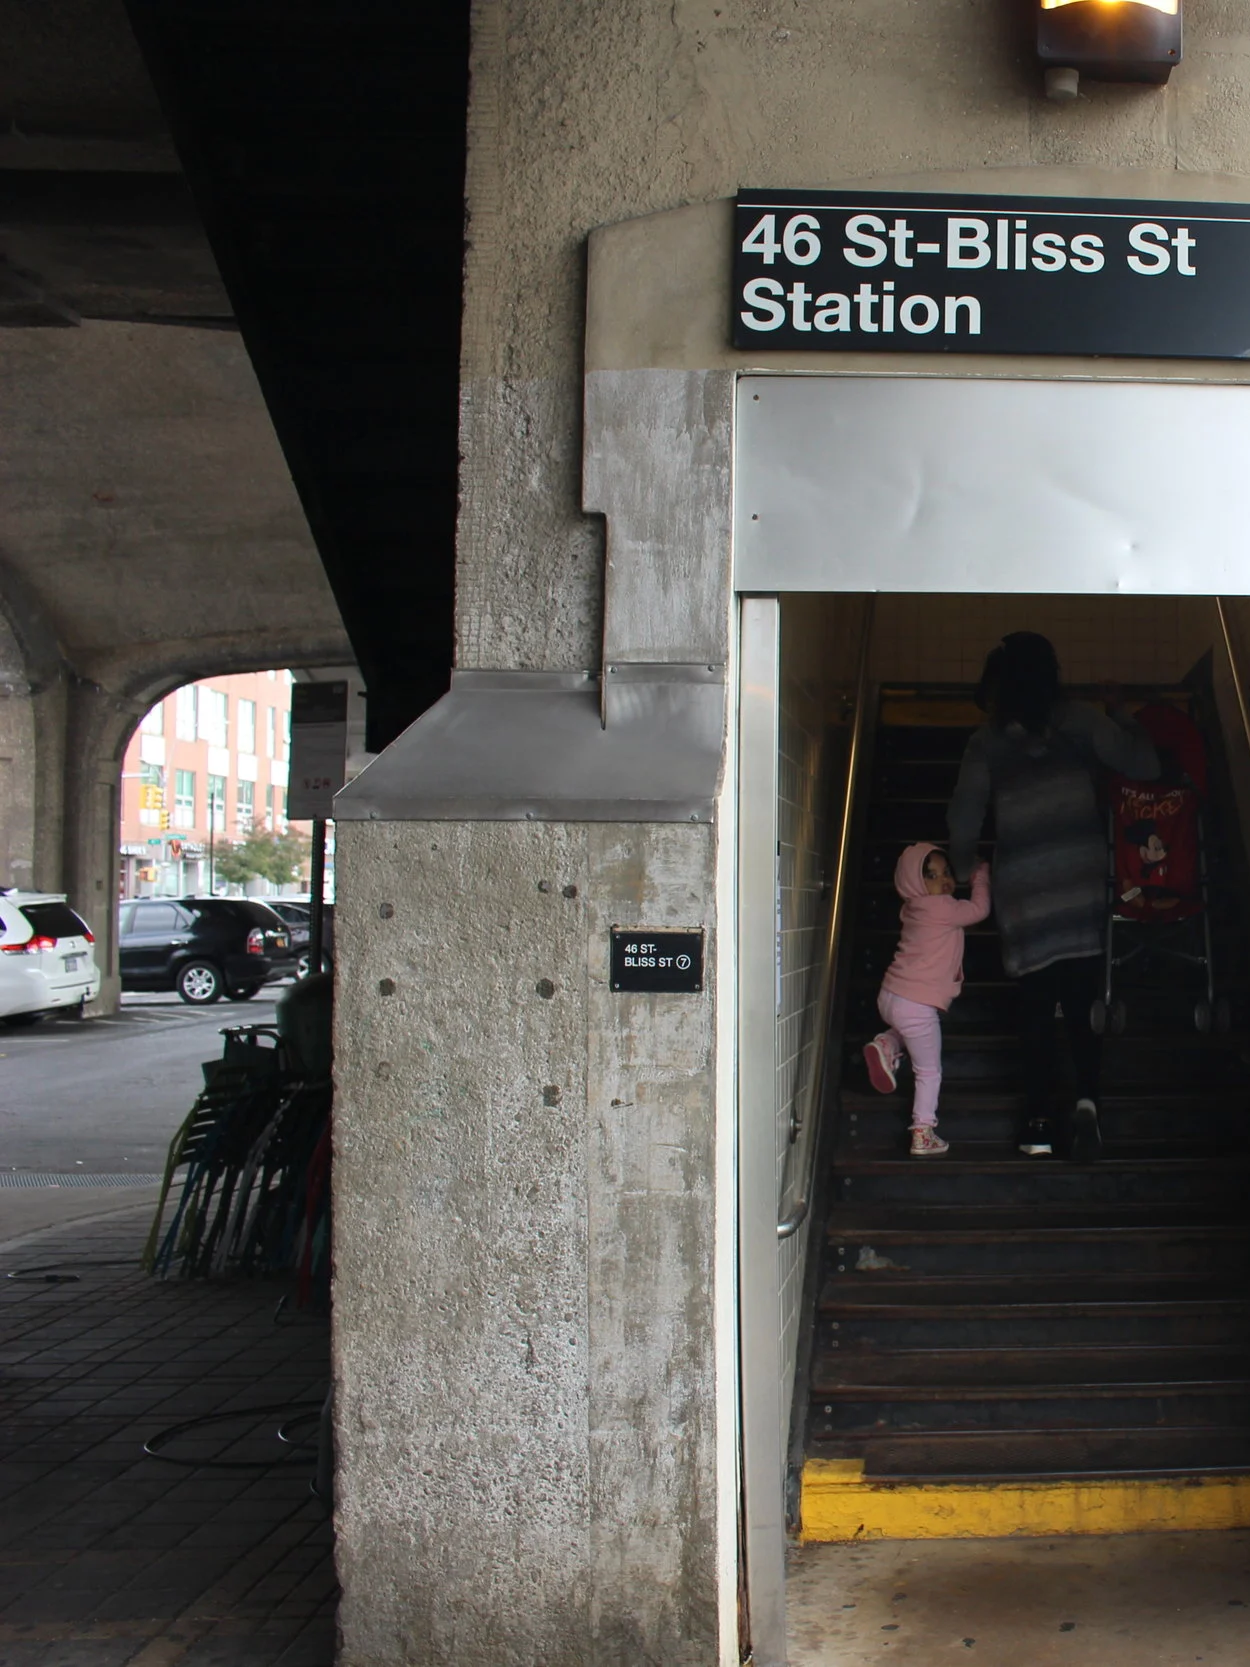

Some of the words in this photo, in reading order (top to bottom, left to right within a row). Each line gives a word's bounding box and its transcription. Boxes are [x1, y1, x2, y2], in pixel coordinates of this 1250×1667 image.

[741, 213, 823, 267] 46
[841, 213, 1105, 275] St-Bliss
[1126, 222, 1198, 277] St
[740, 277, 982, 336] Station
[625, 944, 638, 954] 46
[640, 944, 657, 954] ST-
[625, 957, 656, 967] BLISS
[659, 957, 673, 967] ST
